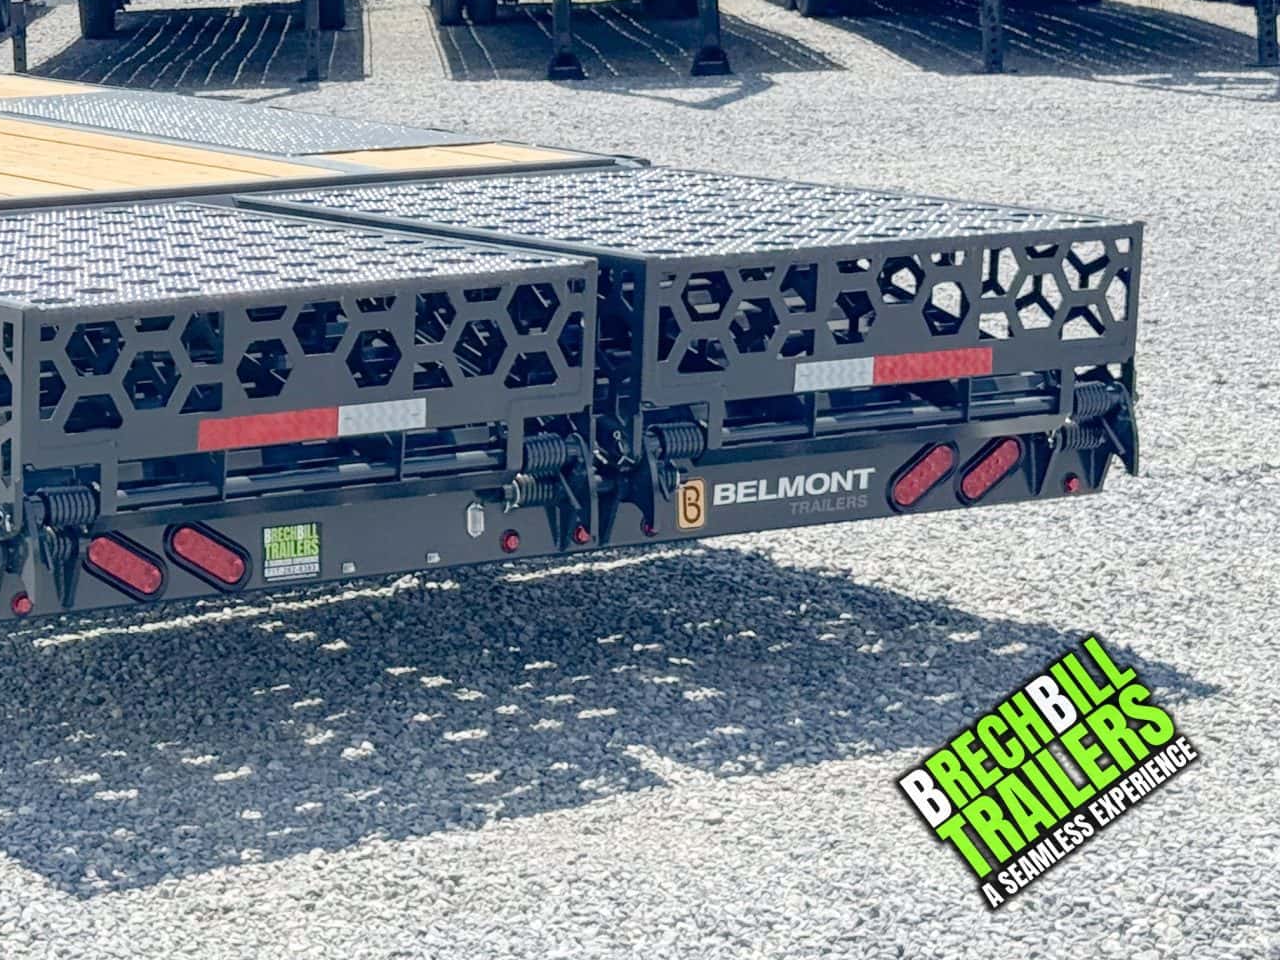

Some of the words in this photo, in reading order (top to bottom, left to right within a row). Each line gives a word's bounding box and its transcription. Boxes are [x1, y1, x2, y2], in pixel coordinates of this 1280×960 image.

[713, 467, 876, 506] BELMONT
[789, 495, 868, 516] TRAILERS
[264, 523, 319, 543] BRECHBILL
[265, 539, 320, 560] TRAILERS
